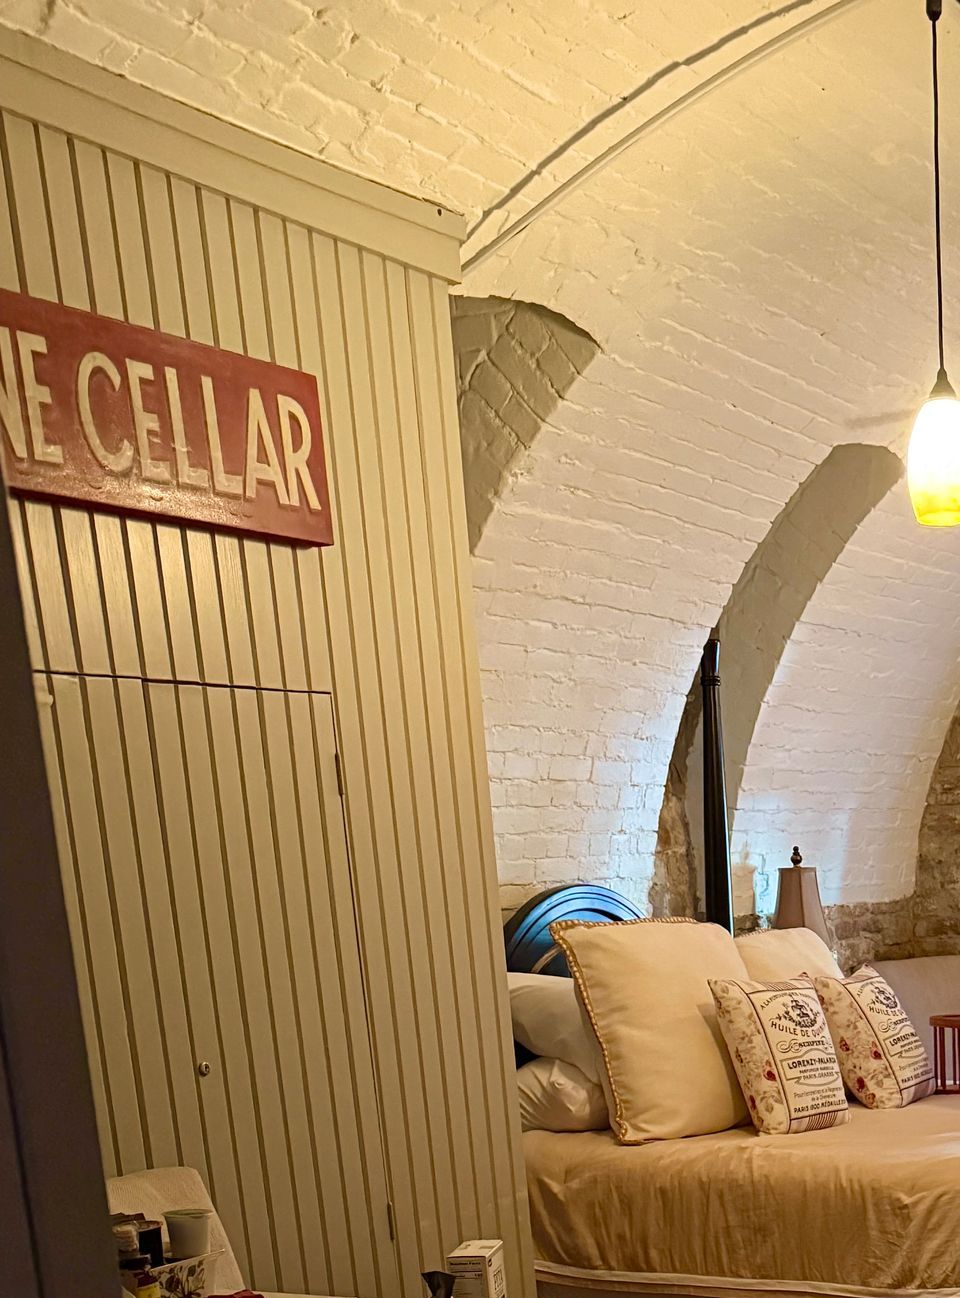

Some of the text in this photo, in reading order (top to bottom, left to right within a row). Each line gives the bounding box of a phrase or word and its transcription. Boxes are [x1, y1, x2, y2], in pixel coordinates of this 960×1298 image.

[76, 351, 322, 512] CELLAR
[771, 1021, 798, 1036] HUILE
[800, 1029, 811, 1038] DE
